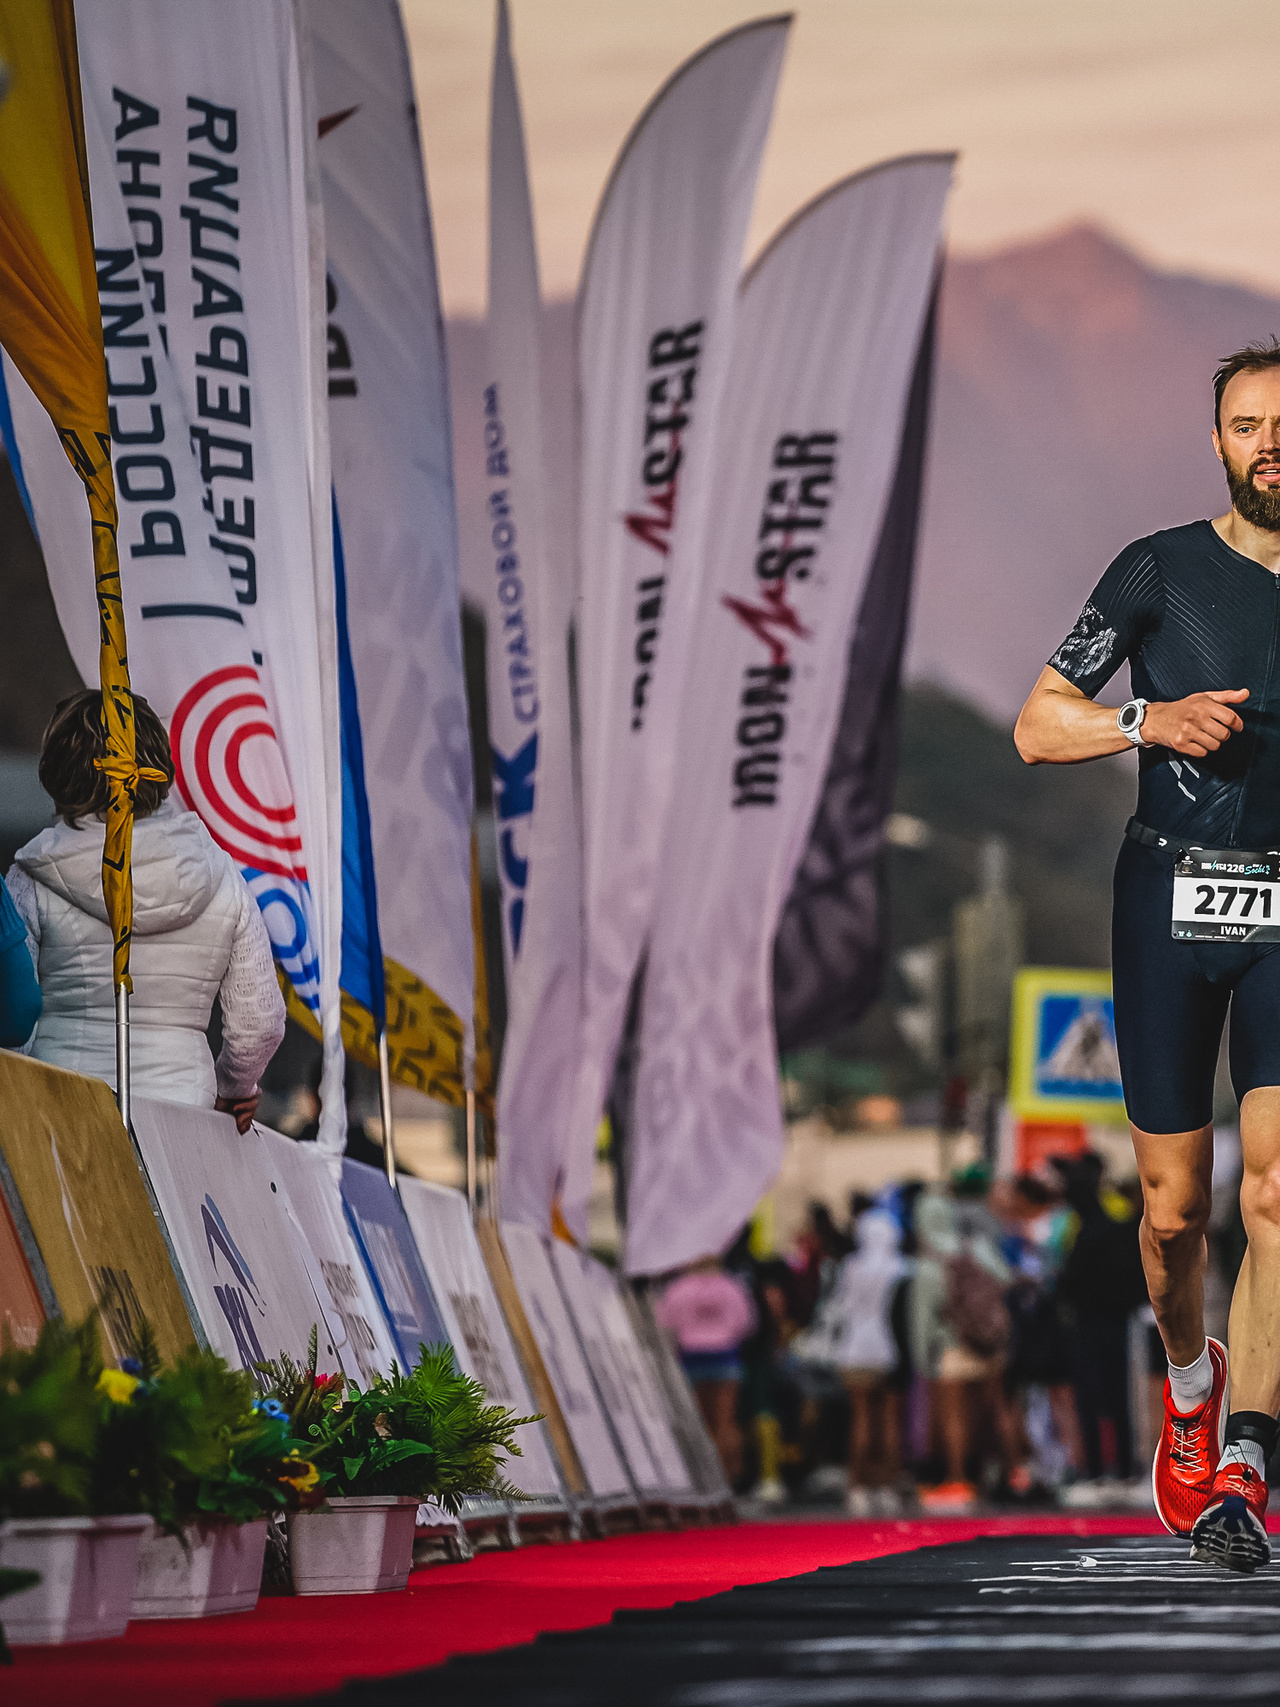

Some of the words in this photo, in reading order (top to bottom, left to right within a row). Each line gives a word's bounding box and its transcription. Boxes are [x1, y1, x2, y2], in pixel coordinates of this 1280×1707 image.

[1226, 863, 1245, 873] 226
[1194, 884, 1272, 919] 2771
[1220, 925, 1247, 936] IVAN
